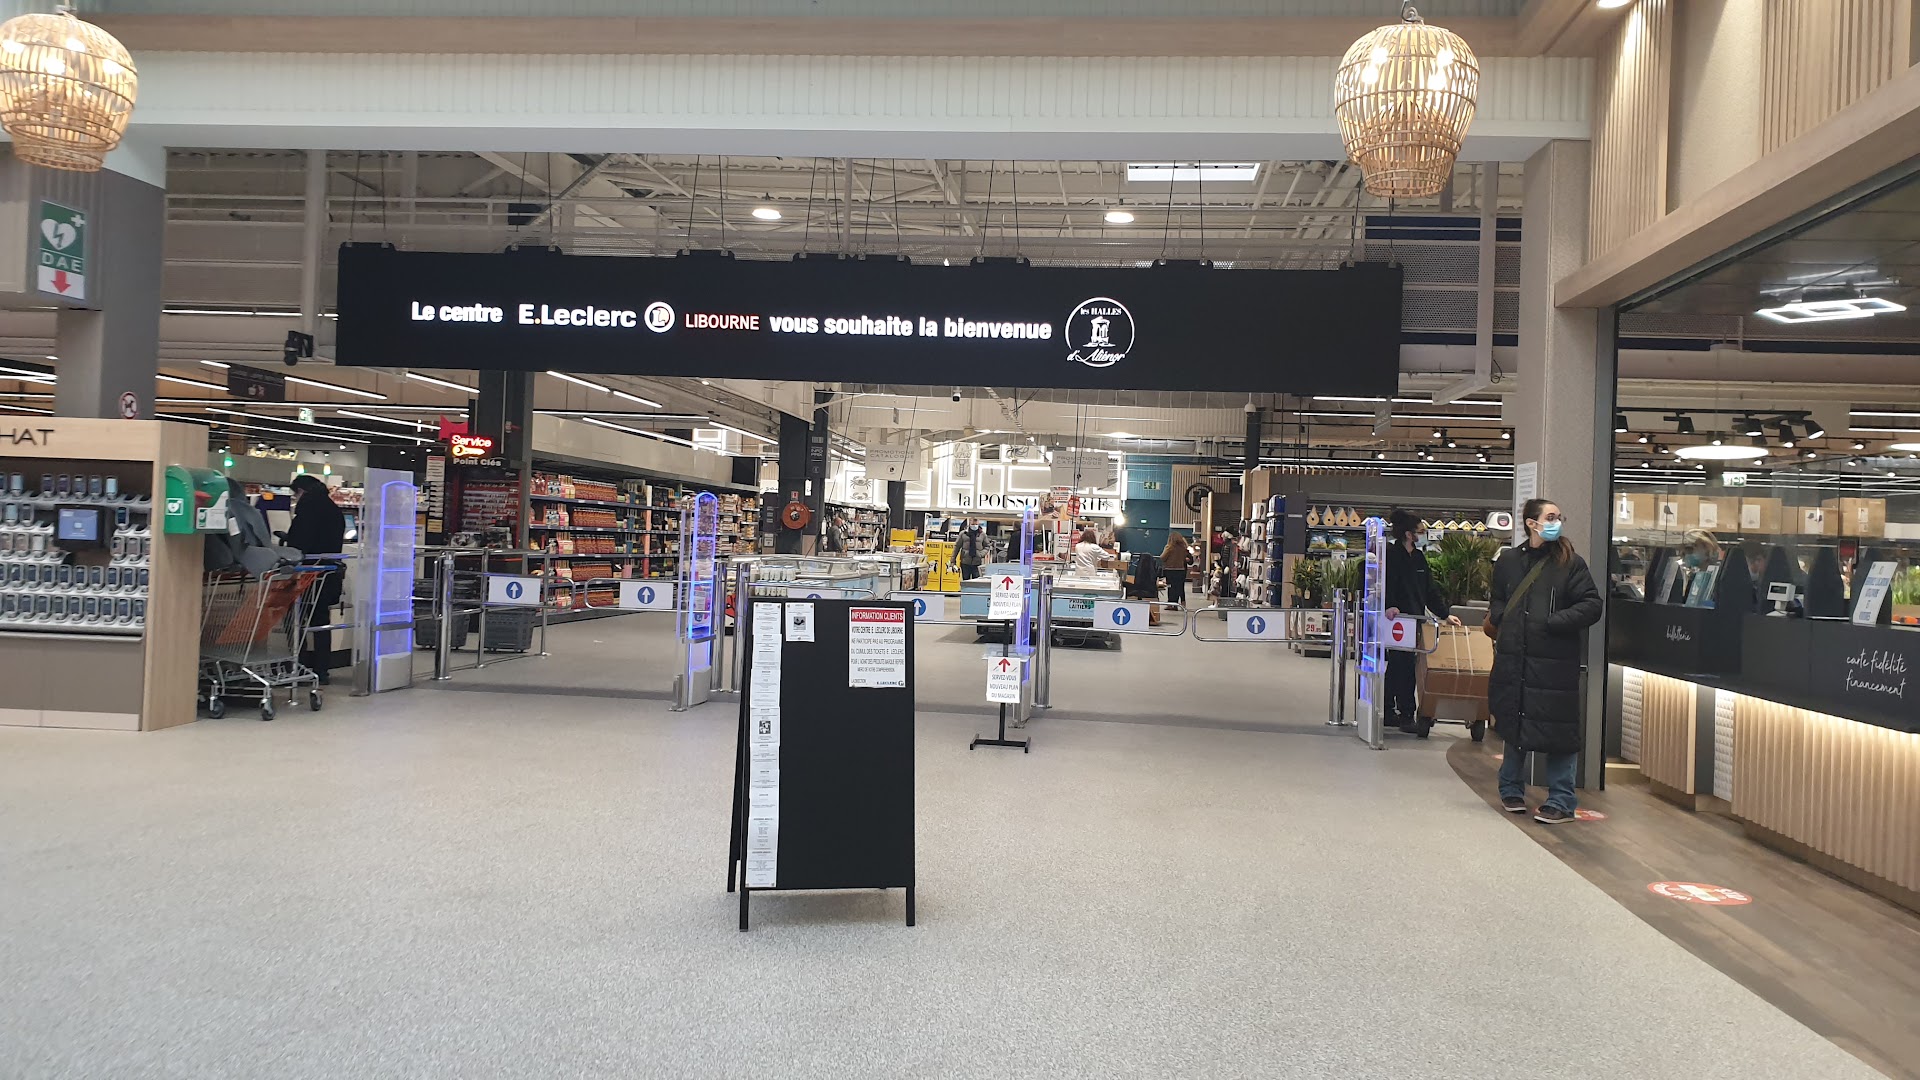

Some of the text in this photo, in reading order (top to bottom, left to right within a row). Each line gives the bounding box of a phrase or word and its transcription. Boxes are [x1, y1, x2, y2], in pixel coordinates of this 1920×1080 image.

[41, 252, 82, 272] DAE
[412, 301, 637, 328] Le centre E.Leclerc
[1091, 307, 1122, 316] HALLES
[685, 313, 1052, 340] LIBOURNE vous souhaite la bienvenue
[451, 434, 492, 448] Service
[453, 457, 502, 467] Point Clés
[957, 493, 971, 506] la
[851, 611, 904, 621] INFORMATION CLIENTS
[1847, 648, 1907, 674] carte fidélité
[1846, 669, 1907, 699] financement
